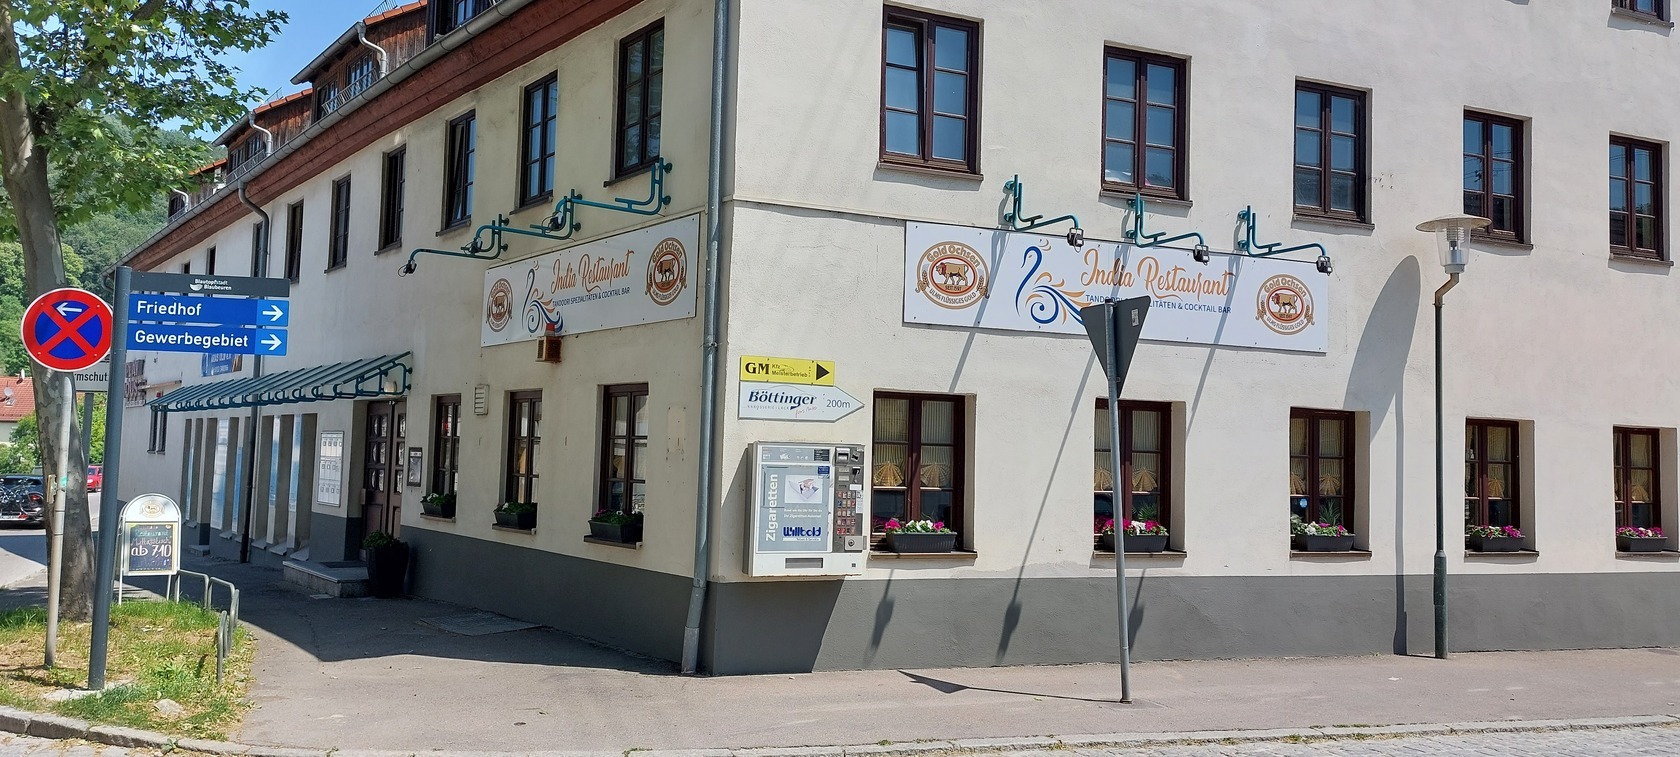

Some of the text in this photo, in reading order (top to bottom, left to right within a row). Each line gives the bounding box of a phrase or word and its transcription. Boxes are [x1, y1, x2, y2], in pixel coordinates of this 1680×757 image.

[926, 245, 981, 268] Gold Ochsen
[551, 249, 635, 294] India Restaurant
[1080, 249, 1236, 301] India Restaurant
[601, 289, 621, 299] COCKTAIL
[621, 286, 631, 295] BAR
[137, 300, 202, 316] Friedhof
[1177, 302, 1183, 310] &
[1184, 302, 1217, 313] COCKTAIL
[1218, 305, 1232, 314] BAR
[135, 330, 248, 349] Gewerbegebiet
[745, 362, 769, 375] GM
[748, 390, 851, 411] Böttinger 200m
[766, 474, 779, 542] Zigaretten
[783, 526, 822, 537] Willbold
[131, 544, 173, 558] ab 7,10
